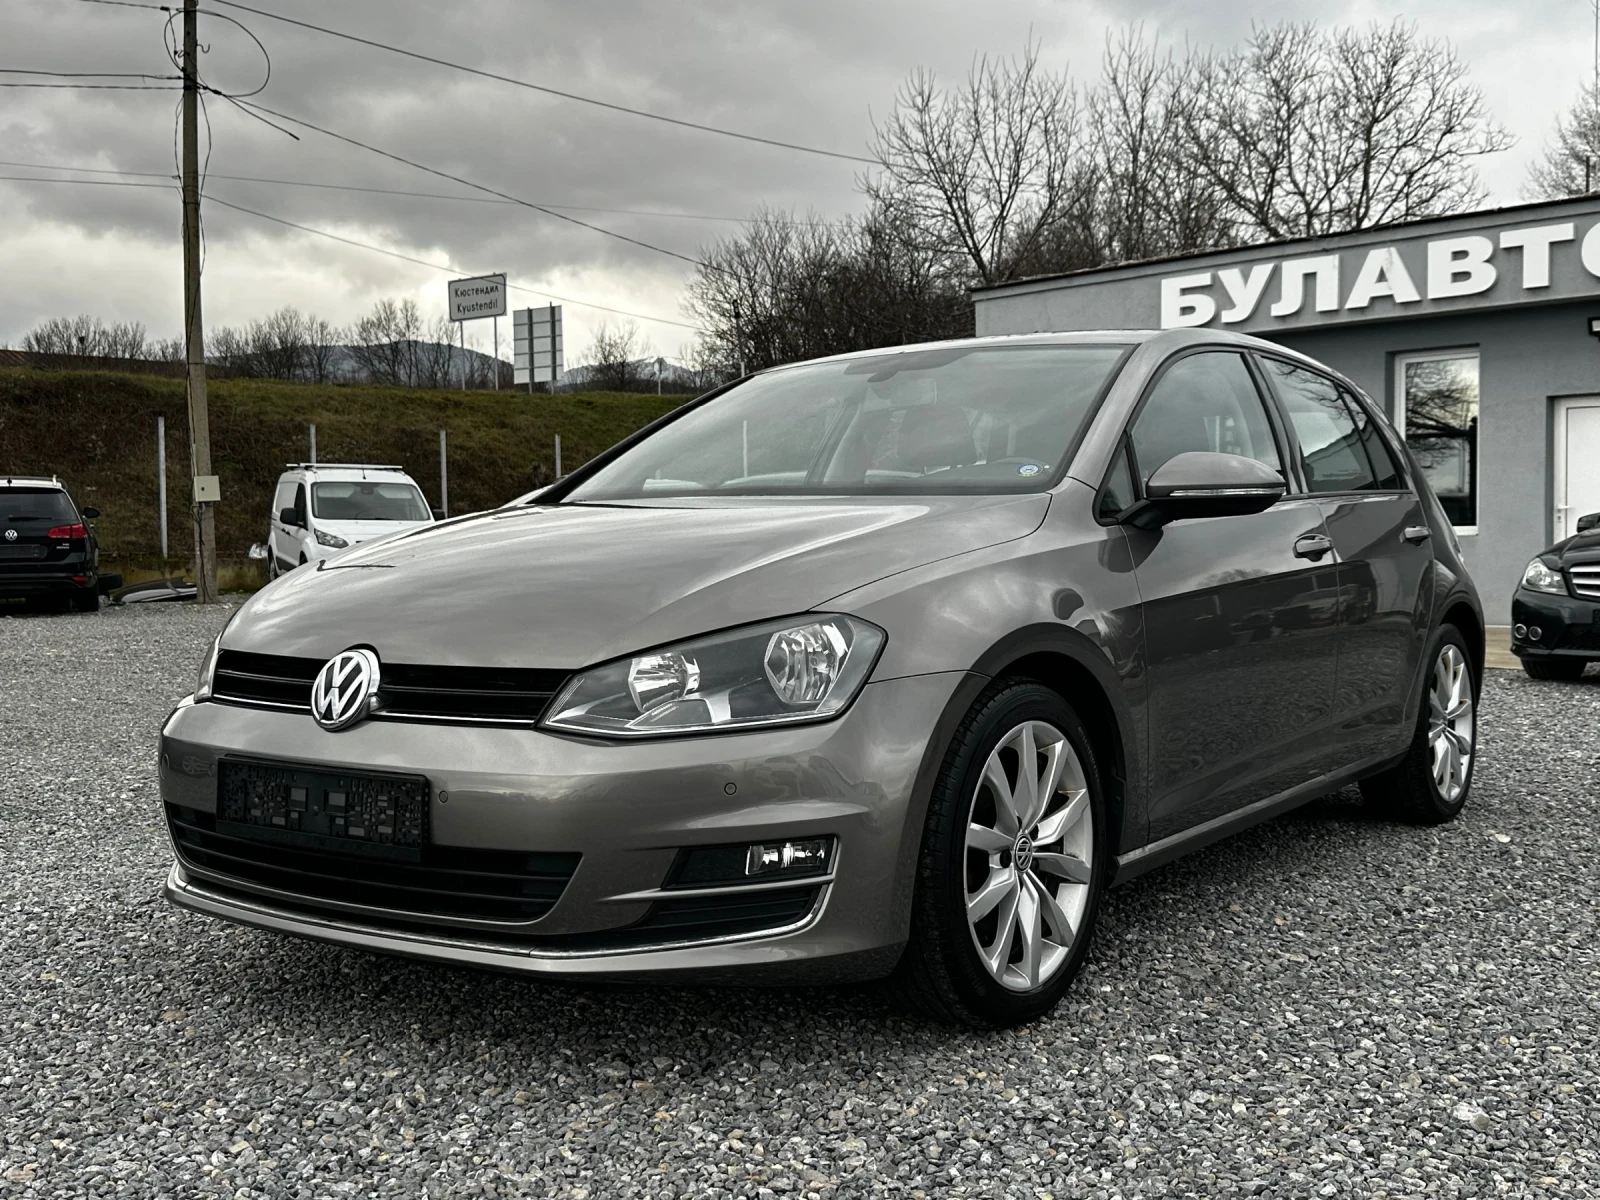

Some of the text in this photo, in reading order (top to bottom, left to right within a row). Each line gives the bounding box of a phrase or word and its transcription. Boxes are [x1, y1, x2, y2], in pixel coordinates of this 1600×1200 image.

[1160, 222, 1600, 329] БУЛАВТ
[454, 285, 499, 298] Кюстендил
[457, 298, 498, 315] Kyustendil
